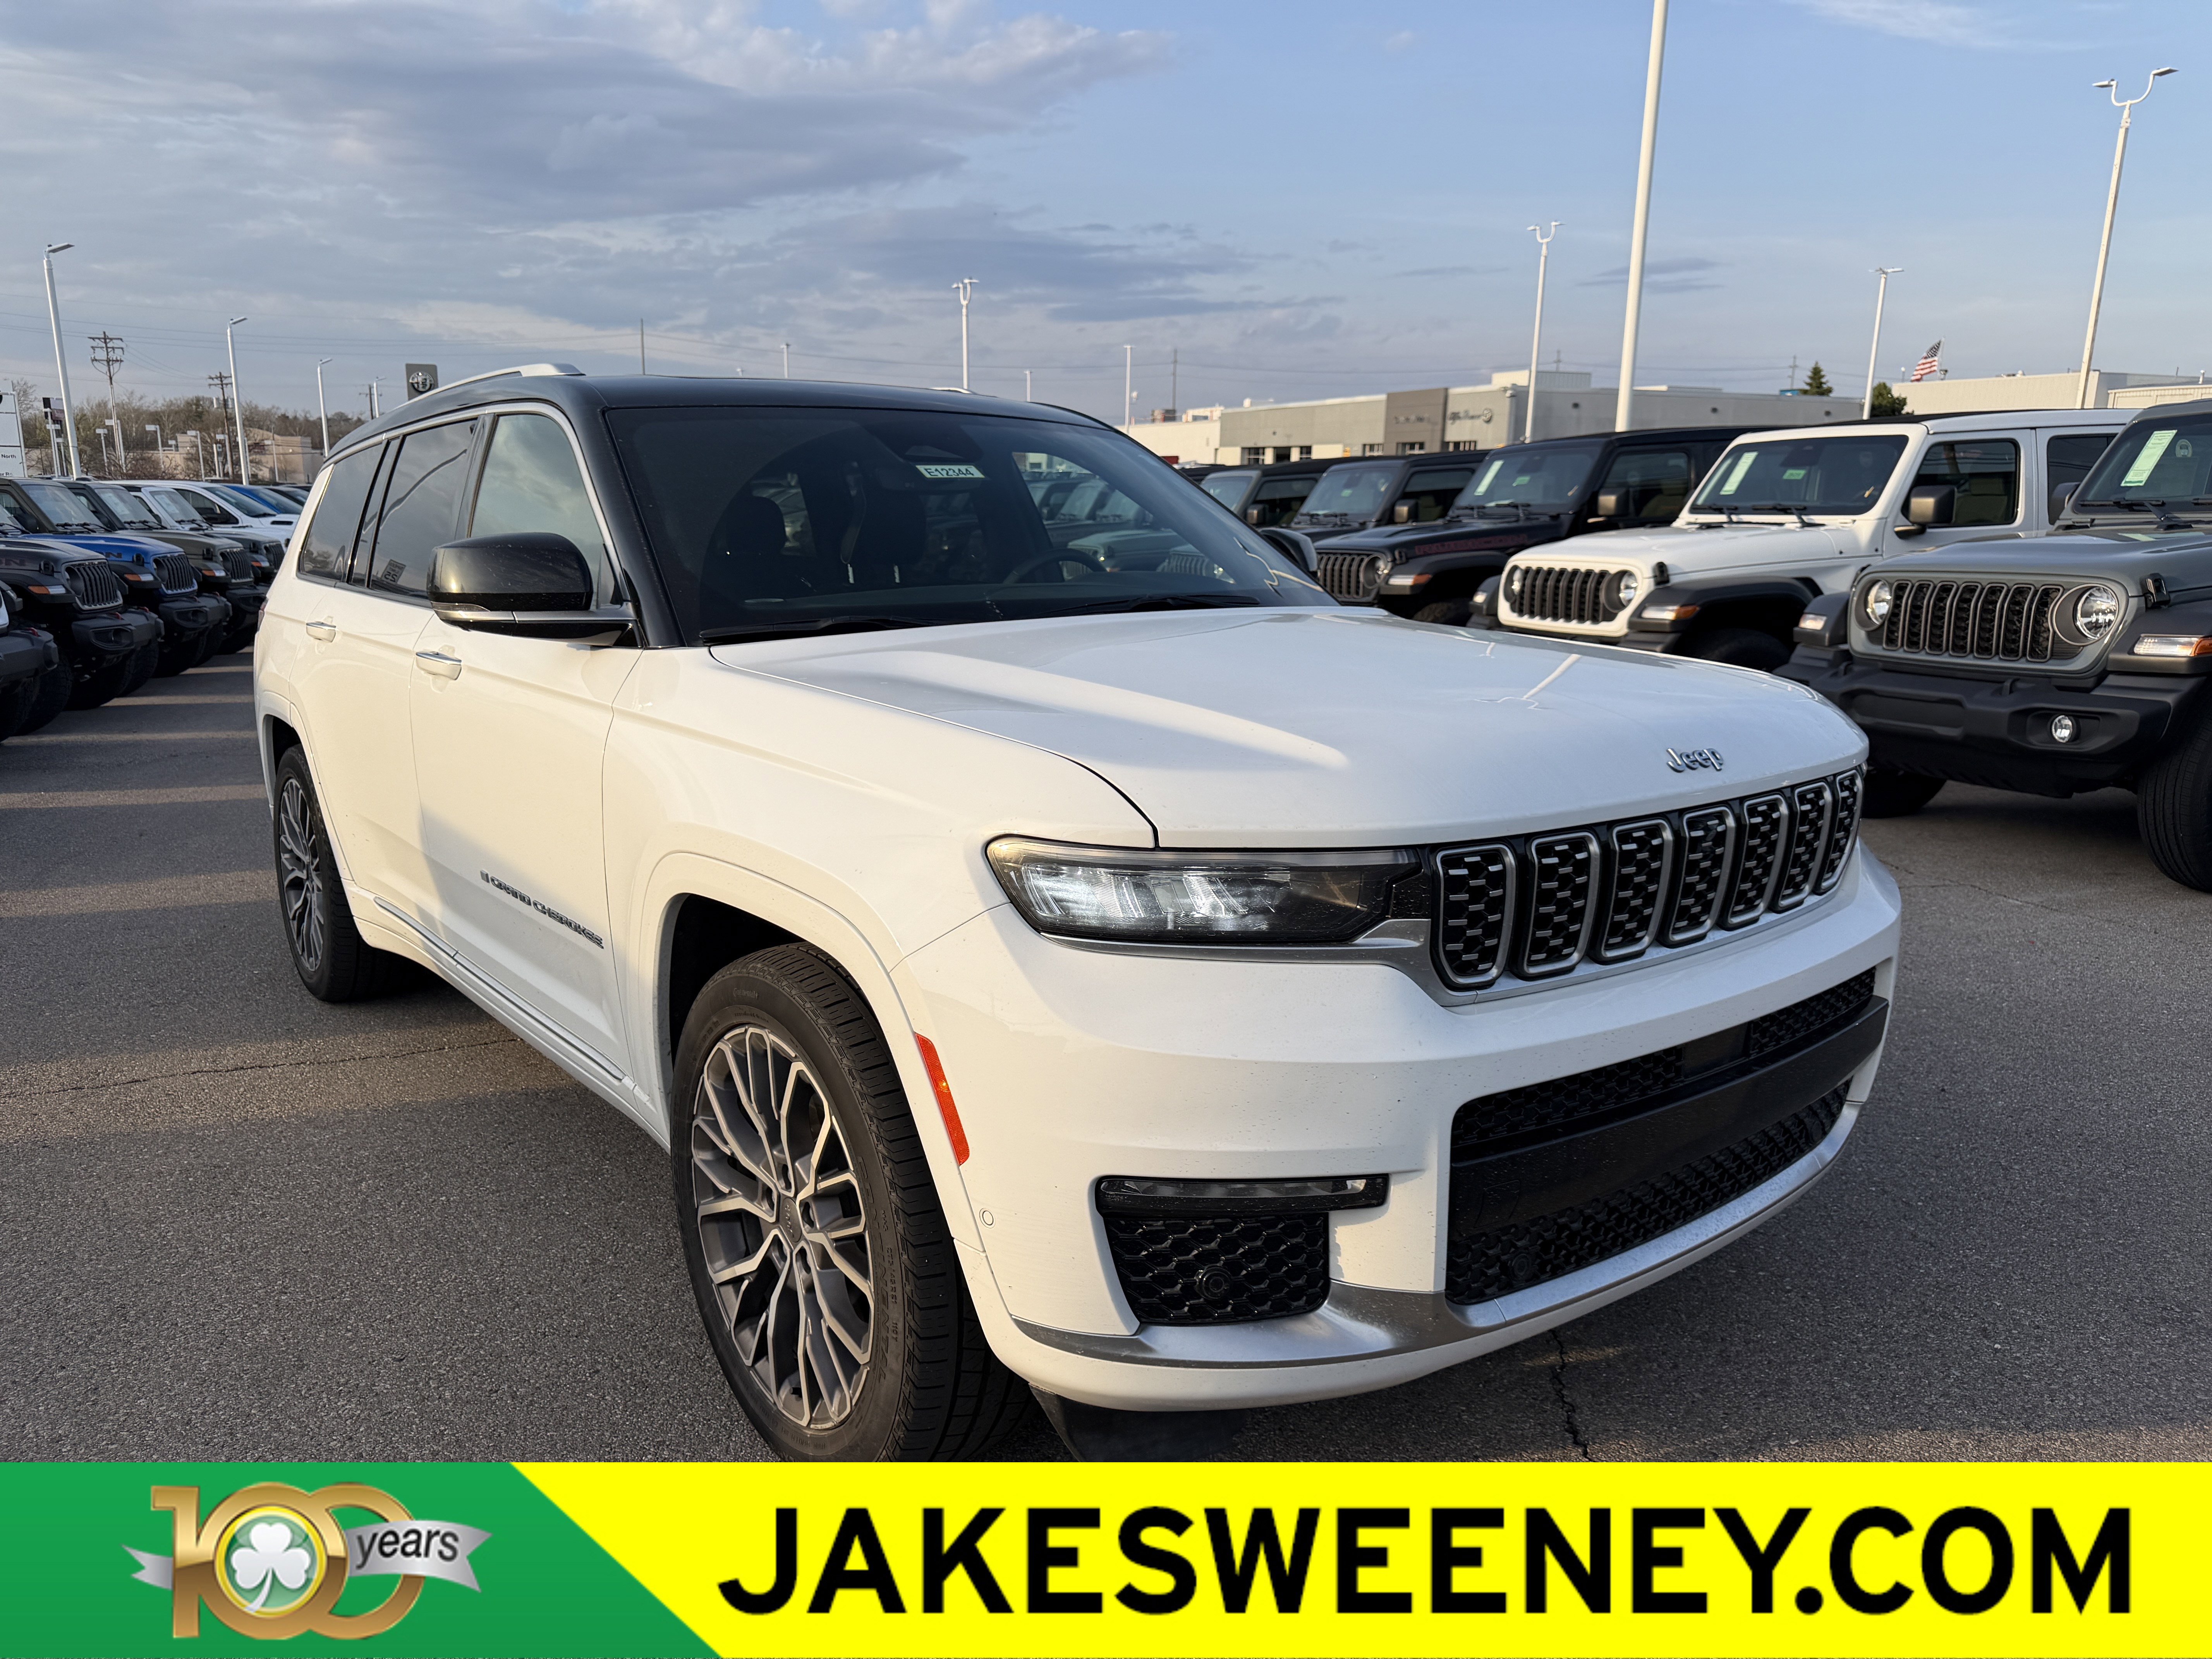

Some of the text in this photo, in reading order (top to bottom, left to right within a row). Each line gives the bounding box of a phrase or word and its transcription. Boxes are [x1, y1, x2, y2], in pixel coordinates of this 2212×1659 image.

[924, 468, 974, 477] E12344
[1666, 748, 1724, 773] Jeep
[490, 876, 605, 950] GRAND CHEROKEE
